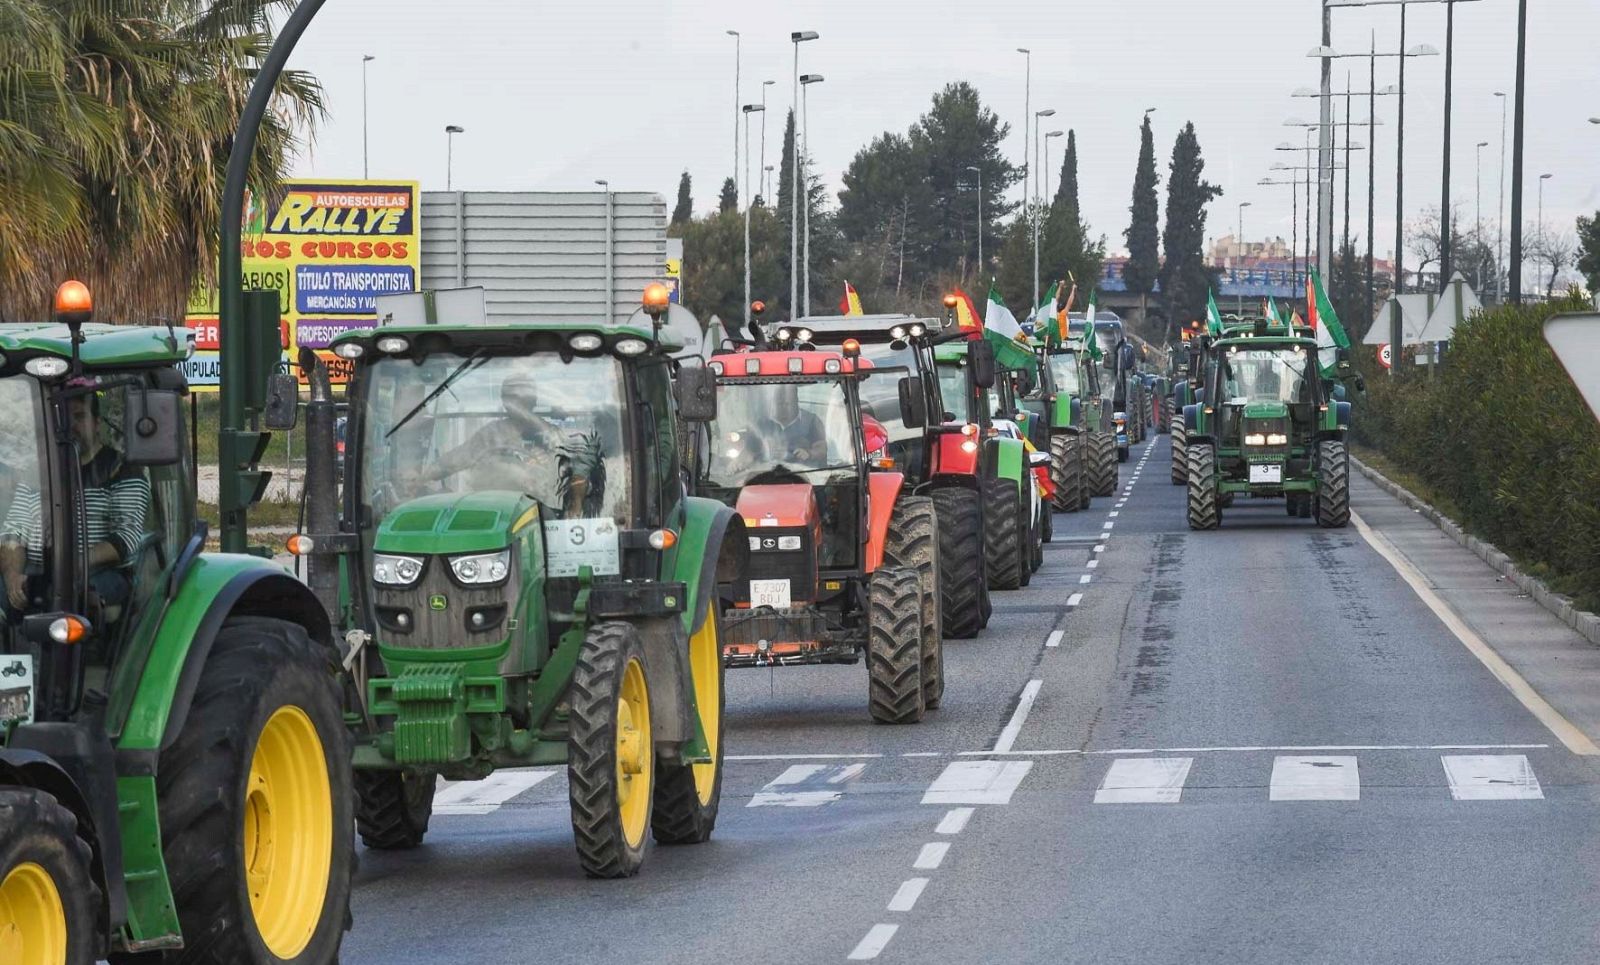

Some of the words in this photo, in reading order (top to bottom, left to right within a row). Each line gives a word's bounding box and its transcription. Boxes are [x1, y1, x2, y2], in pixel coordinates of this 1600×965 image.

[316, 194, 406, 207] AUTOESCUELAS
[270, 192, 405, 234] RALLYE
[301, 241, 409, 259] CURSOS
[297, 267, 331, 291] TÍTULO
[332, 272, 411, 291] TRANSPORTISTA
[306, 293, 357, 309] MERCANCÍAS
[358, 296, 364, 309] Y
[1262, 464, 1269, 474] 3
[570, 525, 586, 546] 3
[753, 583, 760, 593] E
